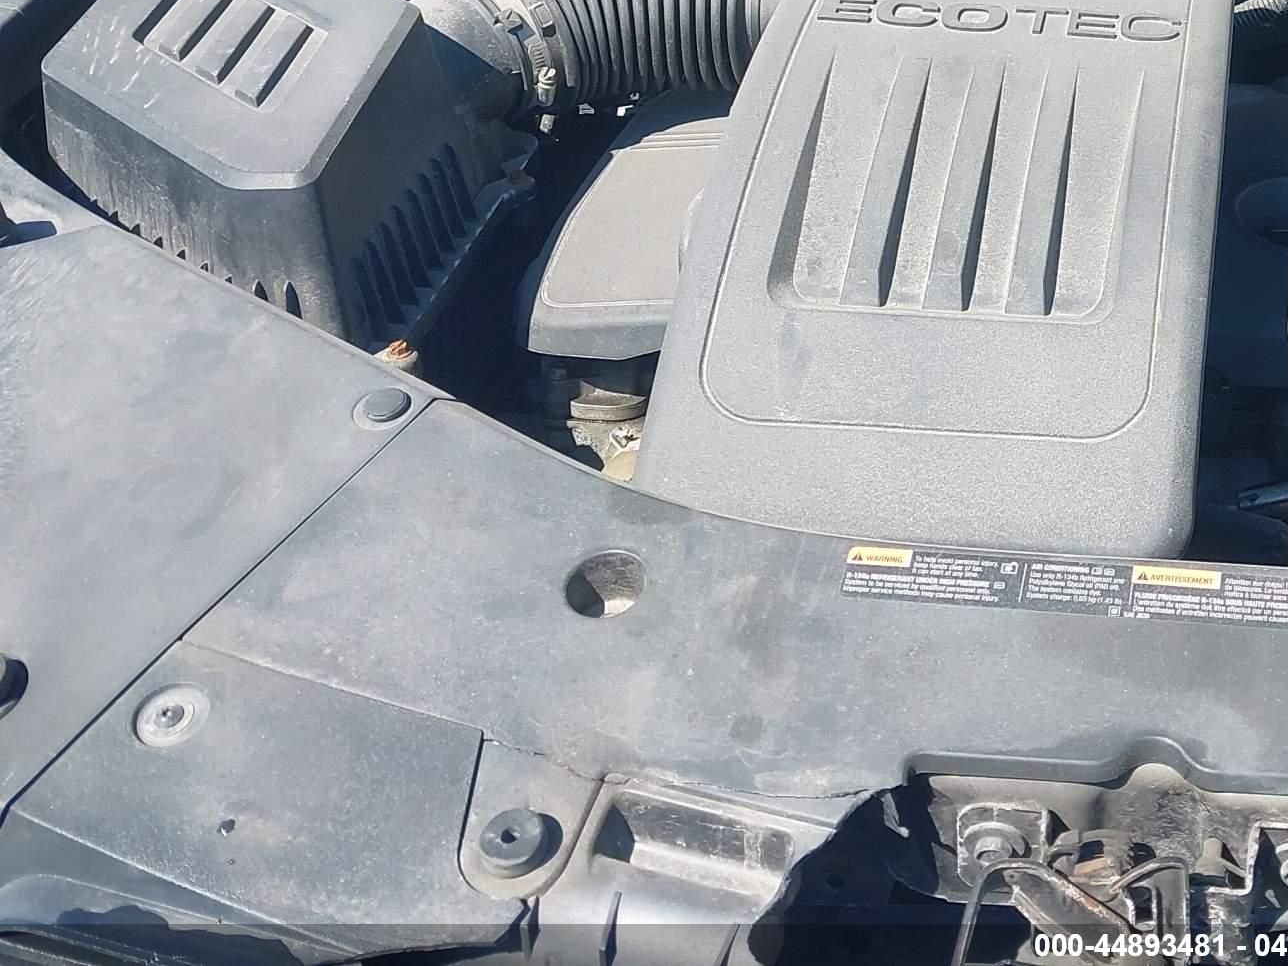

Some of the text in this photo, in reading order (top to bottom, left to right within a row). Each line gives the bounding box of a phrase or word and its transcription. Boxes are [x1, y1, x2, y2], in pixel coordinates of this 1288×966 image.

[866, 555, 903, 563] WARNING
[1044, 565, 1089, 573] CONDITIONING
[845, 579, 867, 587] System
[1151, 574, 1213, 584] AVERTISSEMENT
